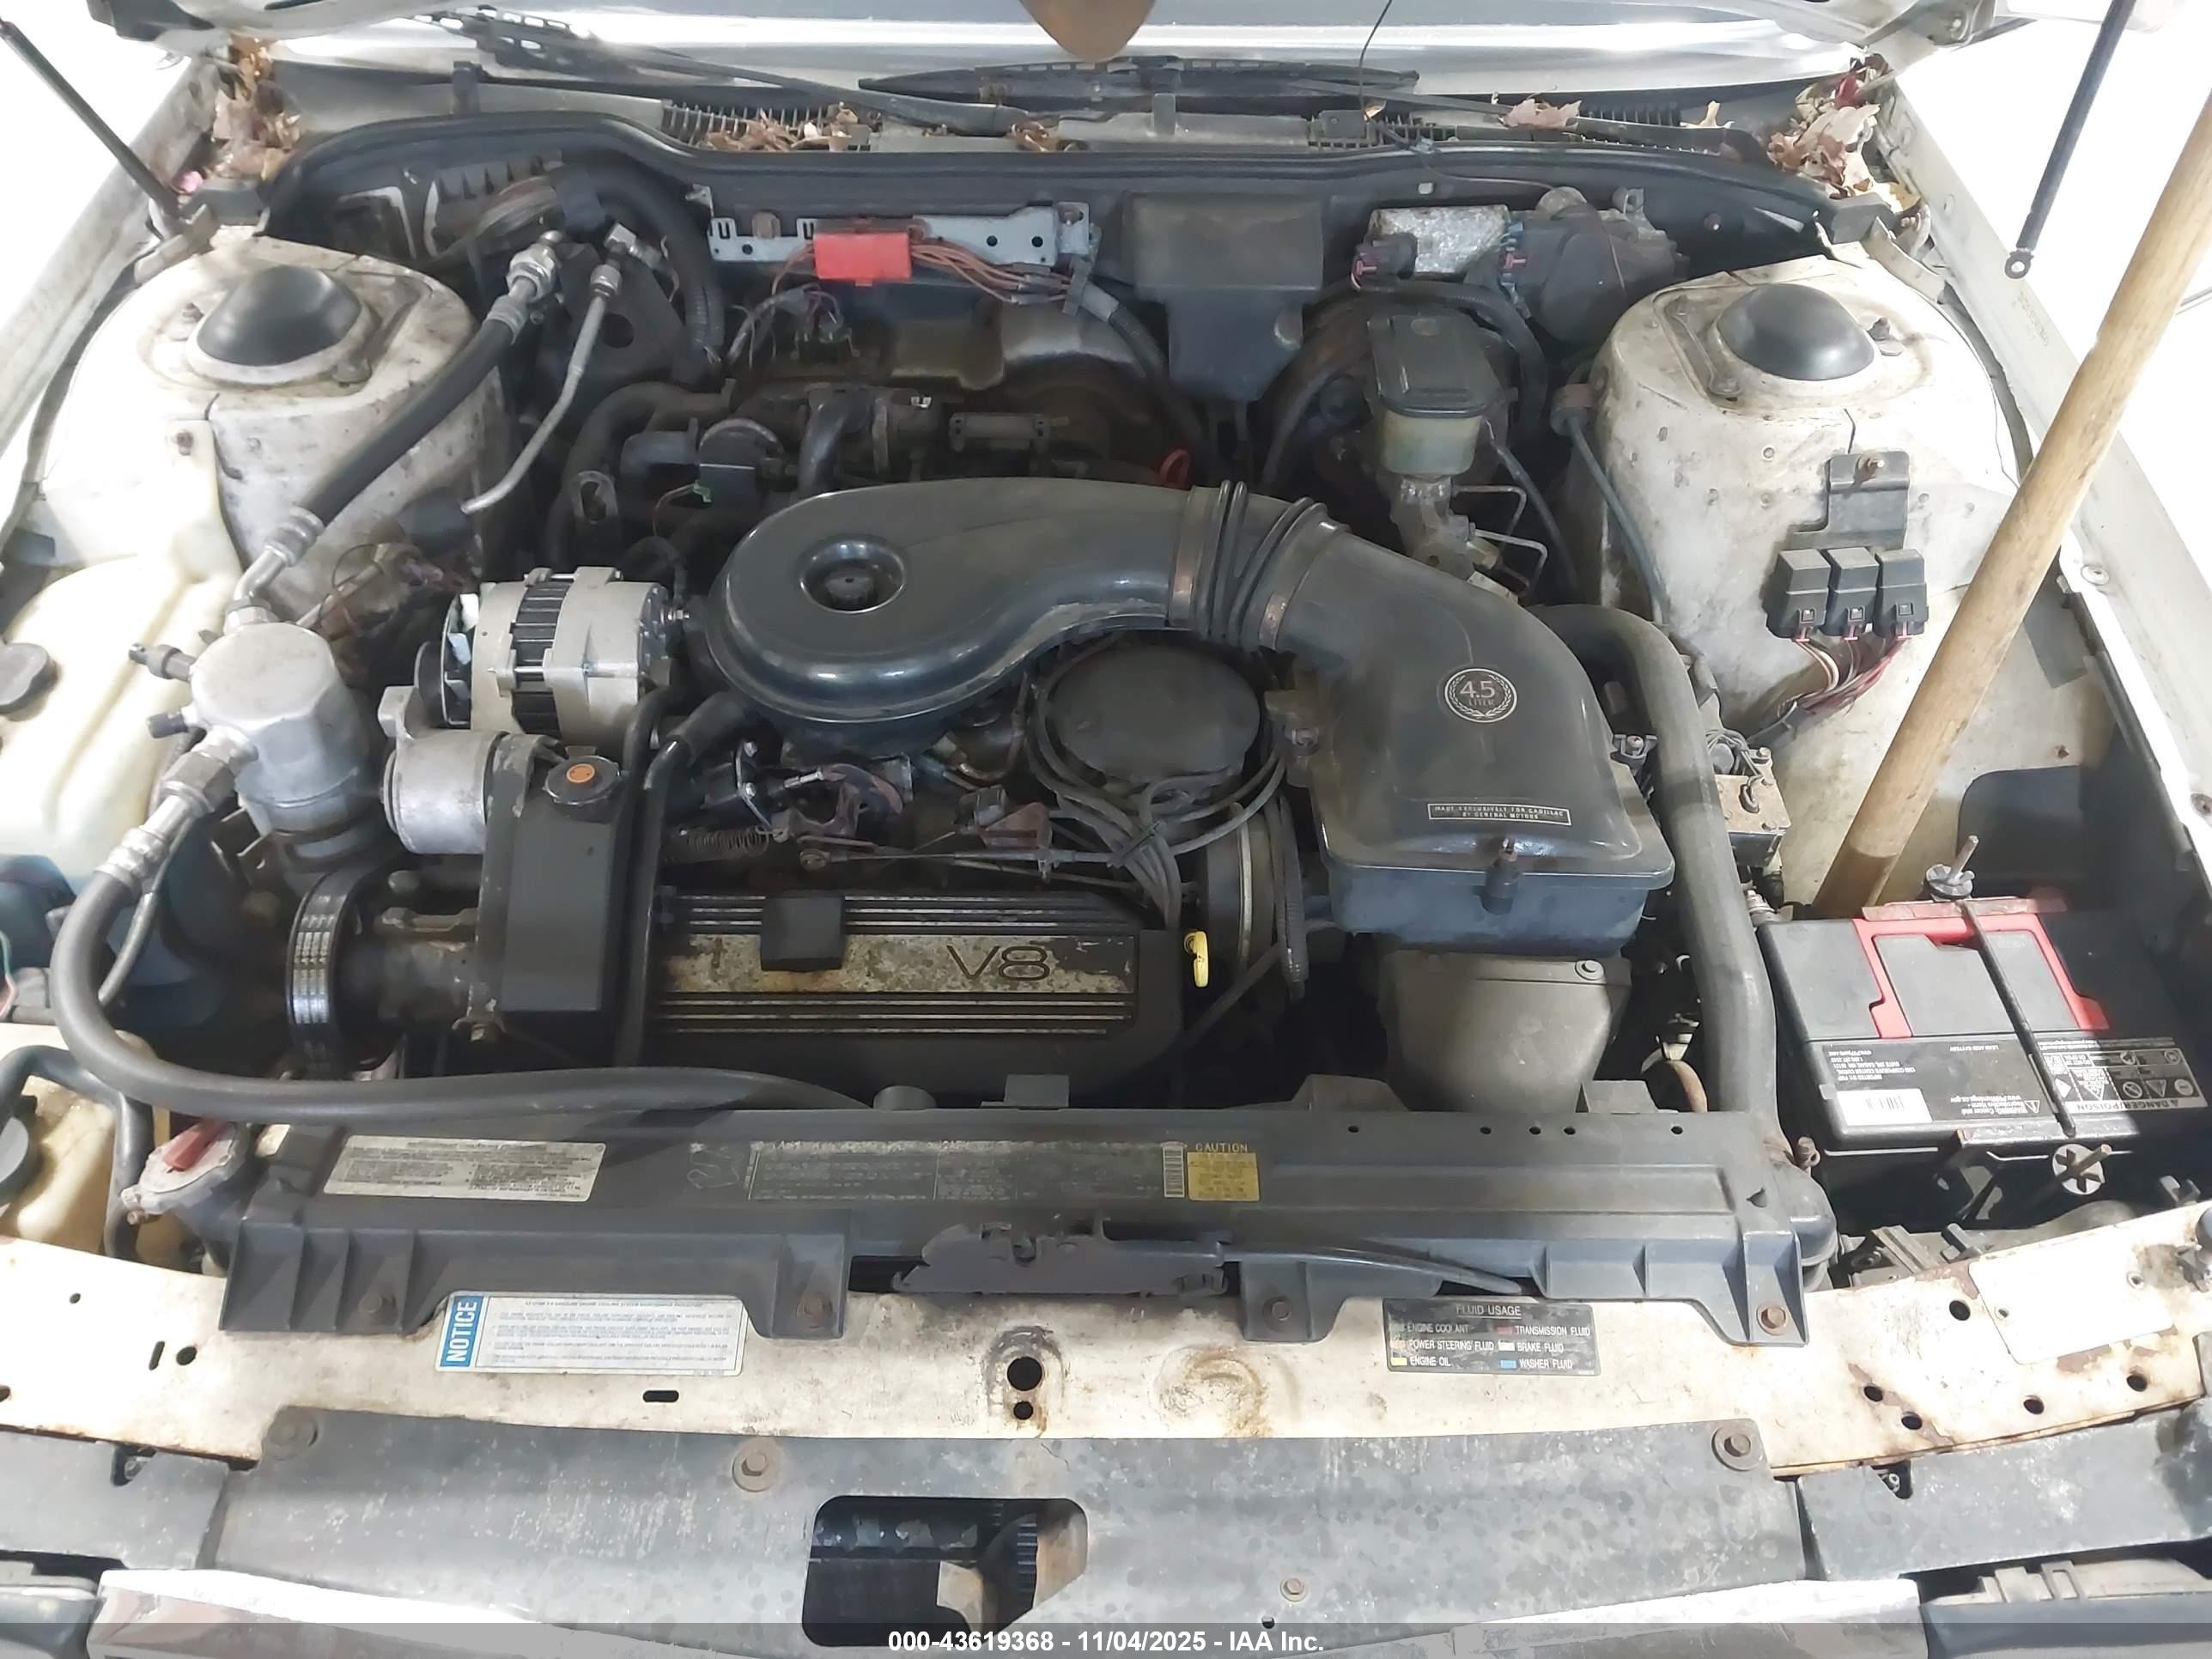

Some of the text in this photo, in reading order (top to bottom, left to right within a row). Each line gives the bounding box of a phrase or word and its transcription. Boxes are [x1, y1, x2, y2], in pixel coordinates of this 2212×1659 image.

[1460, 680, 1496, 698] 4.5
[1528, 808, 1564, 817] CADILLAC
[946, 945, 1050, 981] V8
[2076, 1100, 2170, 1111] DANGER/POISON
[1195, 1141, 1249, 1153] CAUTION
[1456, 1305, 1522, 1316] FLUID USAGE
[446, 1302, 477, 1362] NOTICE
[1407, 1323, 1433, 1333] ENGINE
[1515, 1325, 1591, 1336] TRANSMISSION FLUID
[1409, 1340, 1494, 1351] POWER STEERING FLUID
[1517, 1341, 1565, 1353] BRAKE FLUID
[1410, 1356, 1451, 1367] ENGINE OIL
[1519, 1358, 1573, 1369] WASHER FLUID
